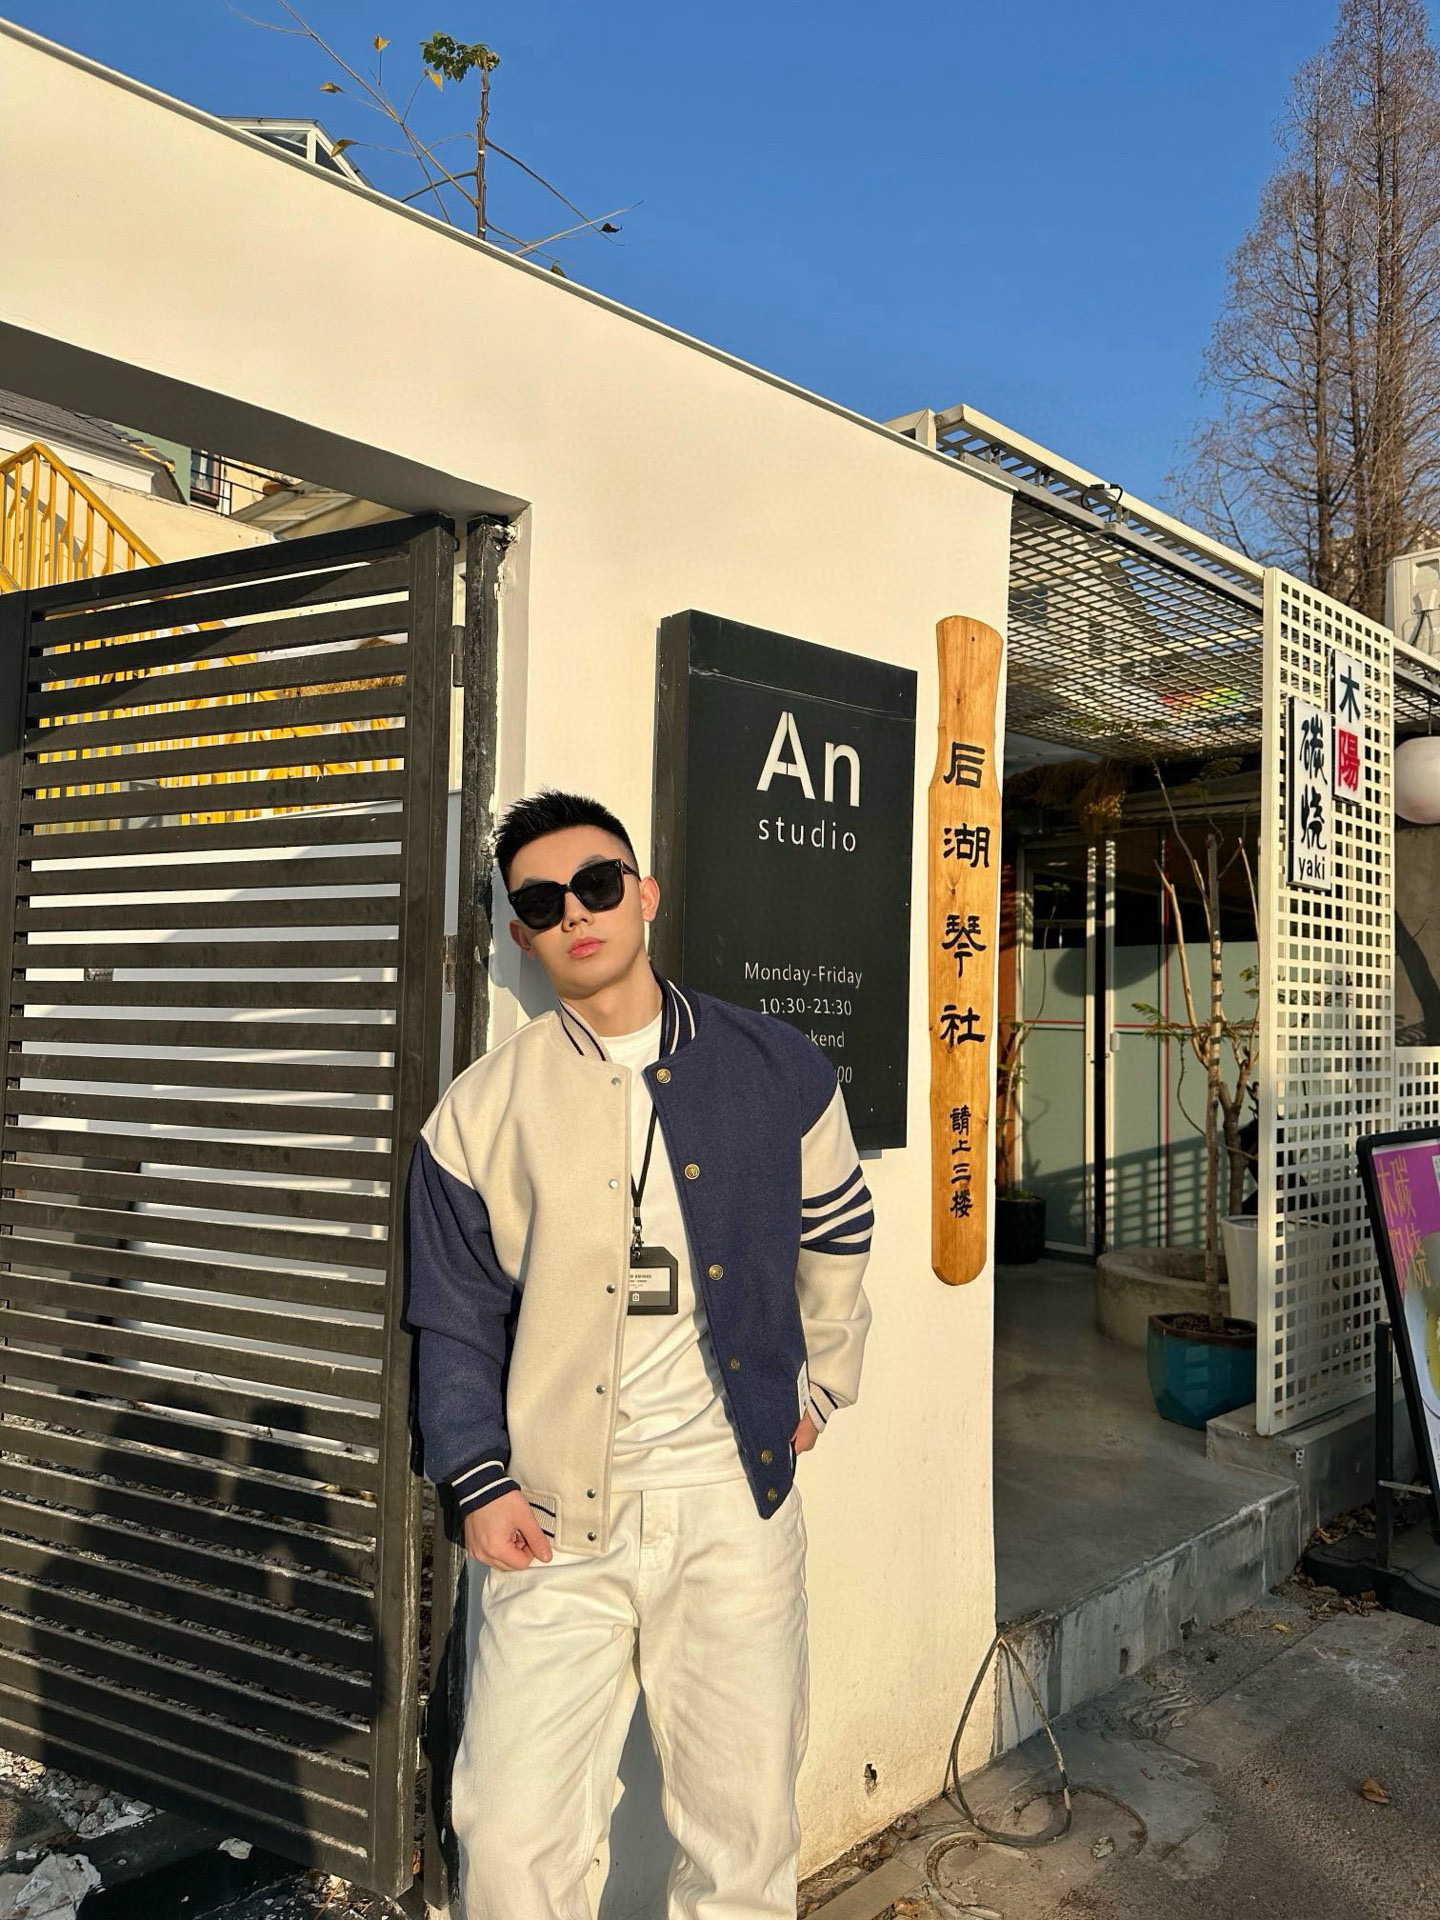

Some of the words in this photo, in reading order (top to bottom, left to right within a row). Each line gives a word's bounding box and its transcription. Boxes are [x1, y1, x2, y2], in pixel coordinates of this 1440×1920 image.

[1338, 664, 1362, 793] 木陽
[756, 711, 861, 808] An
[758, 816, 857, 852] studio
[1299, 854, 1326, 881] yaki
[940, 741, 991, 1048] 后湖琴社
[744, 961, 863, 989] Monday-Friday
[759, 997, 853, 1016] 10:30-21:30
[804, 1029, 845, 1048] kend
